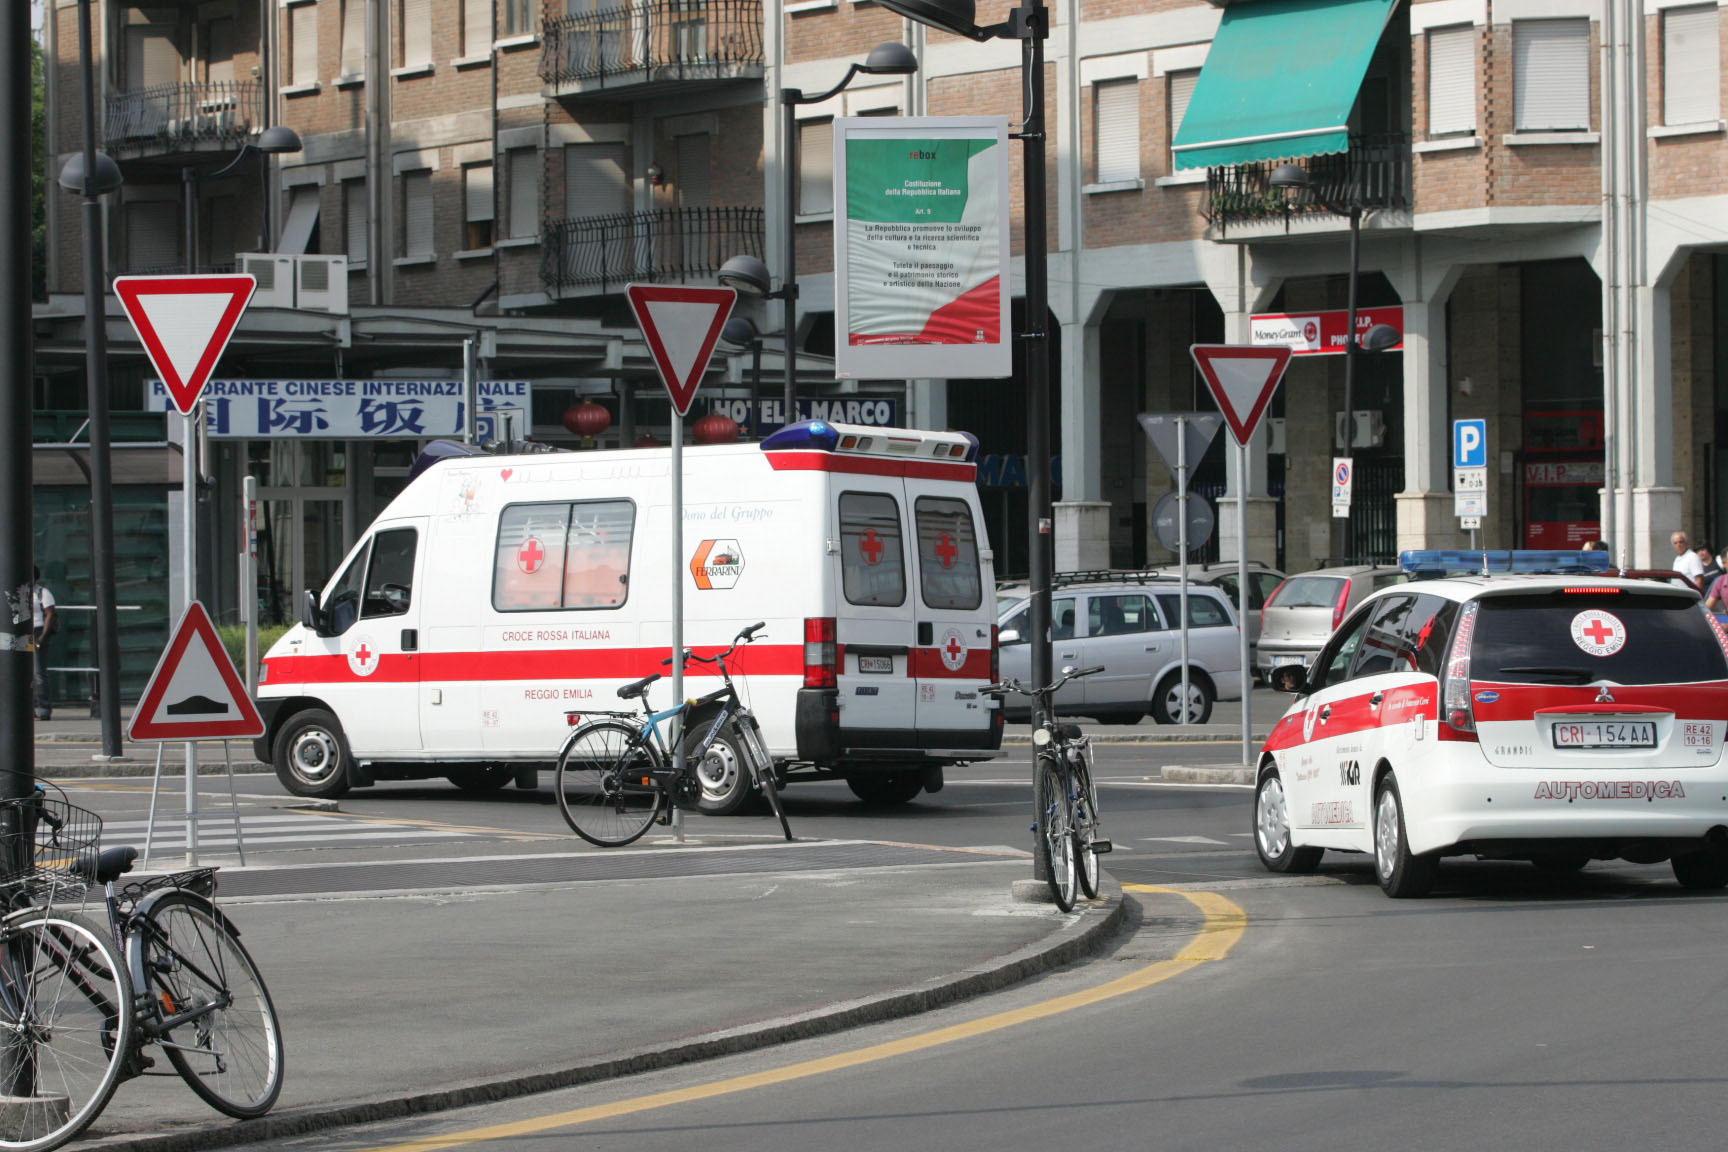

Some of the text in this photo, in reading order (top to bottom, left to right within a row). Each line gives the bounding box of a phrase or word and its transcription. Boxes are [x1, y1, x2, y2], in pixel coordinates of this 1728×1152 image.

[902, 188, 936, 197] Repubblica
[912, 225, 944, 233] promuove
[954, 225, 982, 234] sviluppo
[920, 262, 954, 270] paesaggio
[916, 280, 934, 288] della
[935, 281, 961, 289] Nazione
[154, 382, 526, 396] RORANTE CINESE INTERNAZINALE
[714, 400, 784, 424] HOEL
[811, 401, 890, 425] MARCO
[1460, 426, 1480, 463] P
[710, 506, 726, 519] del
[731, 506, 774, 522] Gruppo
[696, 566, 740, 577] FERRARINI
[502, 630, 611, 641] CROCE ROSSA ITALIANA
[524, 689, 593, 700] REGGIO EMILIA
[1686, 725, 1711, 734] RE 42
[1534, 780, 1686, 800] AUTOMEDICA
